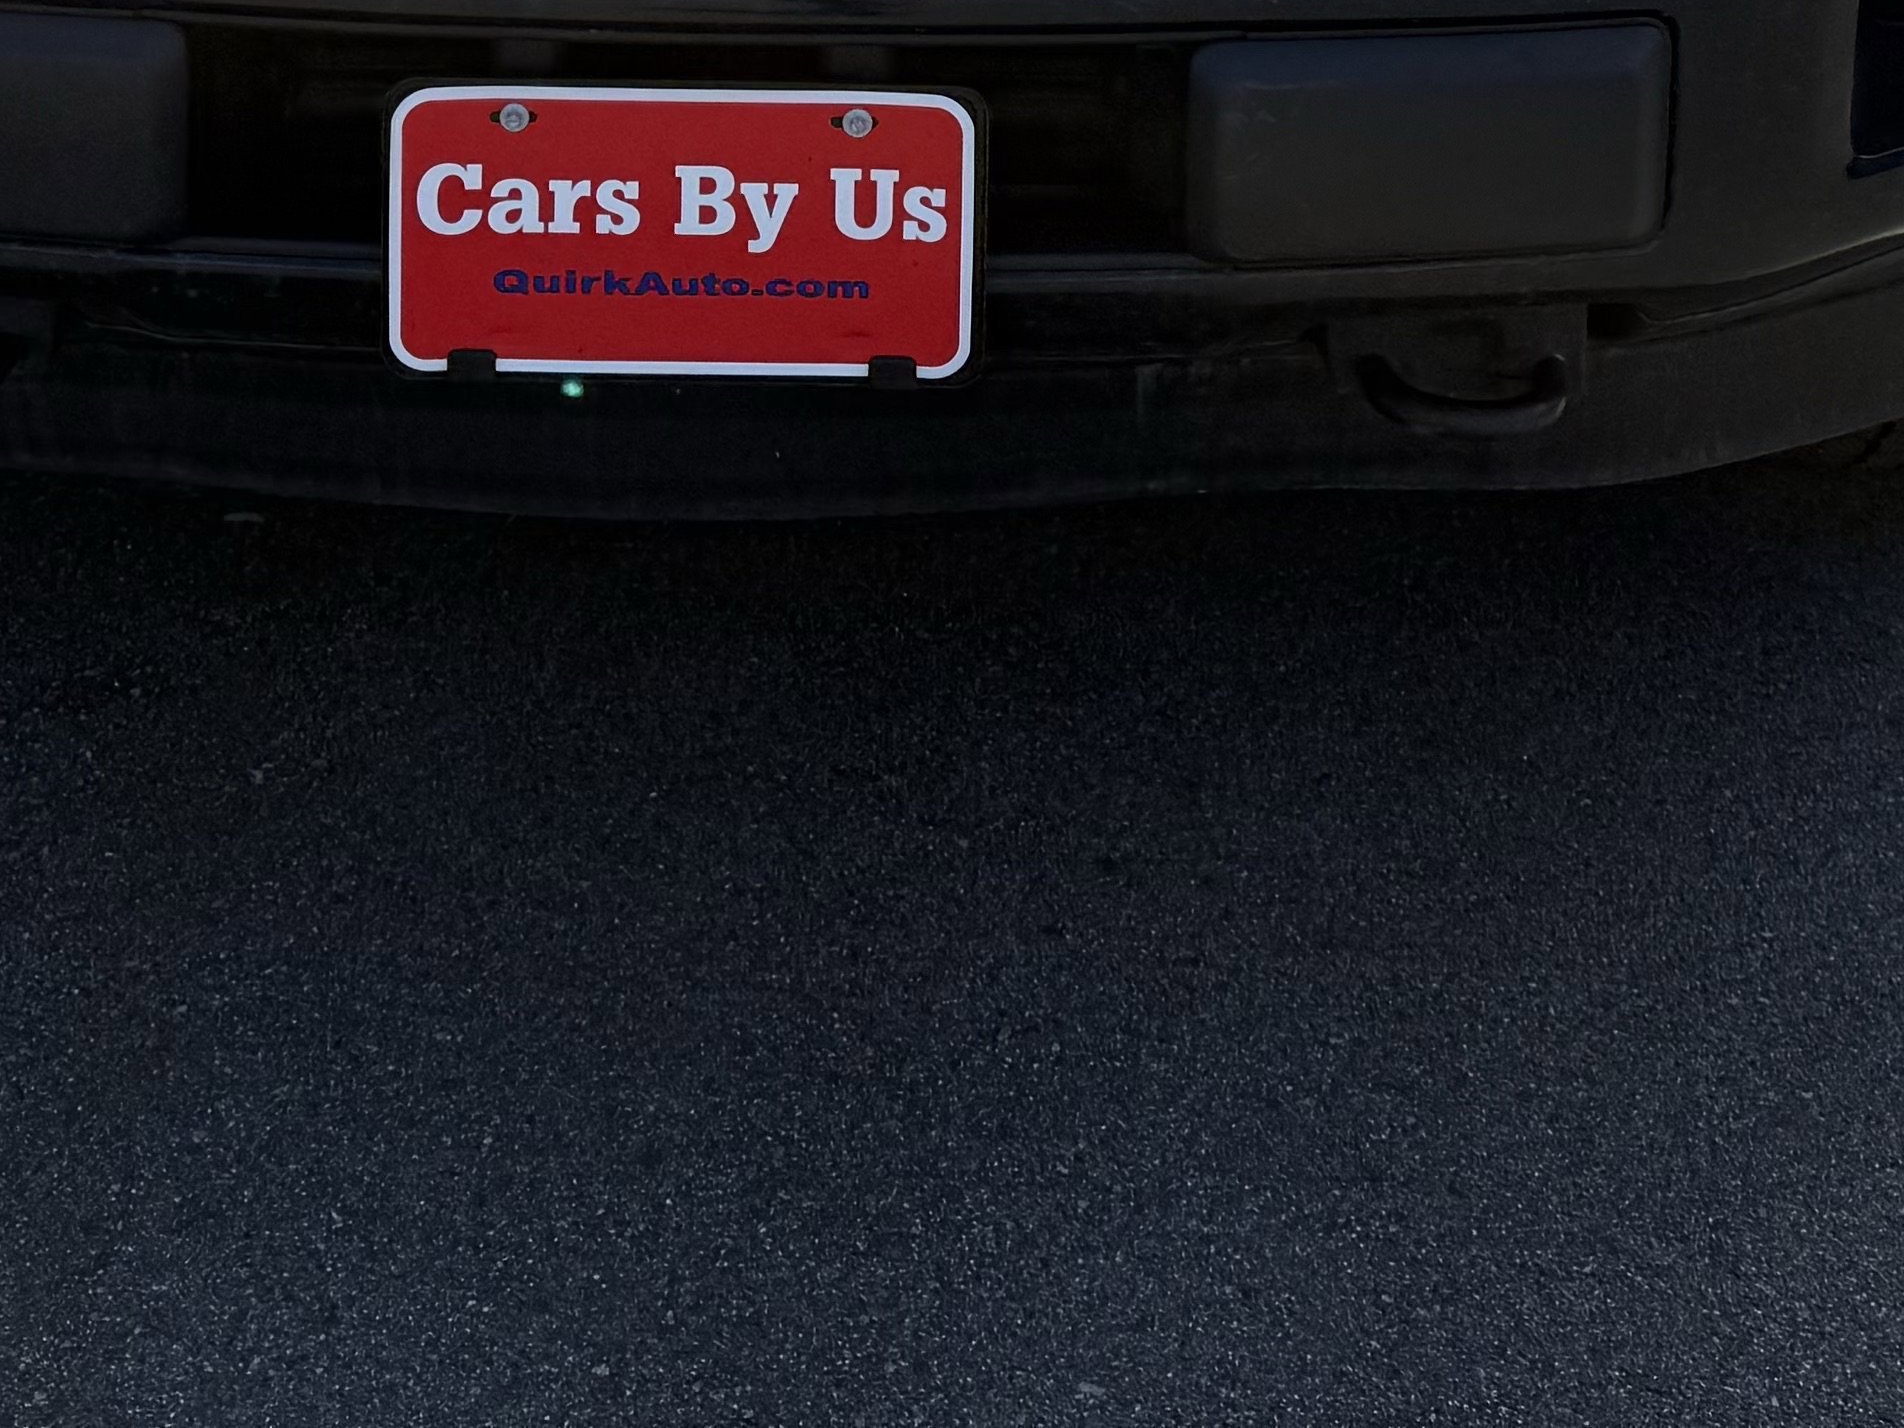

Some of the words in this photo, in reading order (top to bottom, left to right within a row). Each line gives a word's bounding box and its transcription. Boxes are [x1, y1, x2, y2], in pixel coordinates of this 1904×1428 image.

[416, 162, 641, 236] Cars
[673, 164, 799, 254] By
[829, 167, 948, 243] Us
[493, 268, 870, 300] QuirkAuto.com
